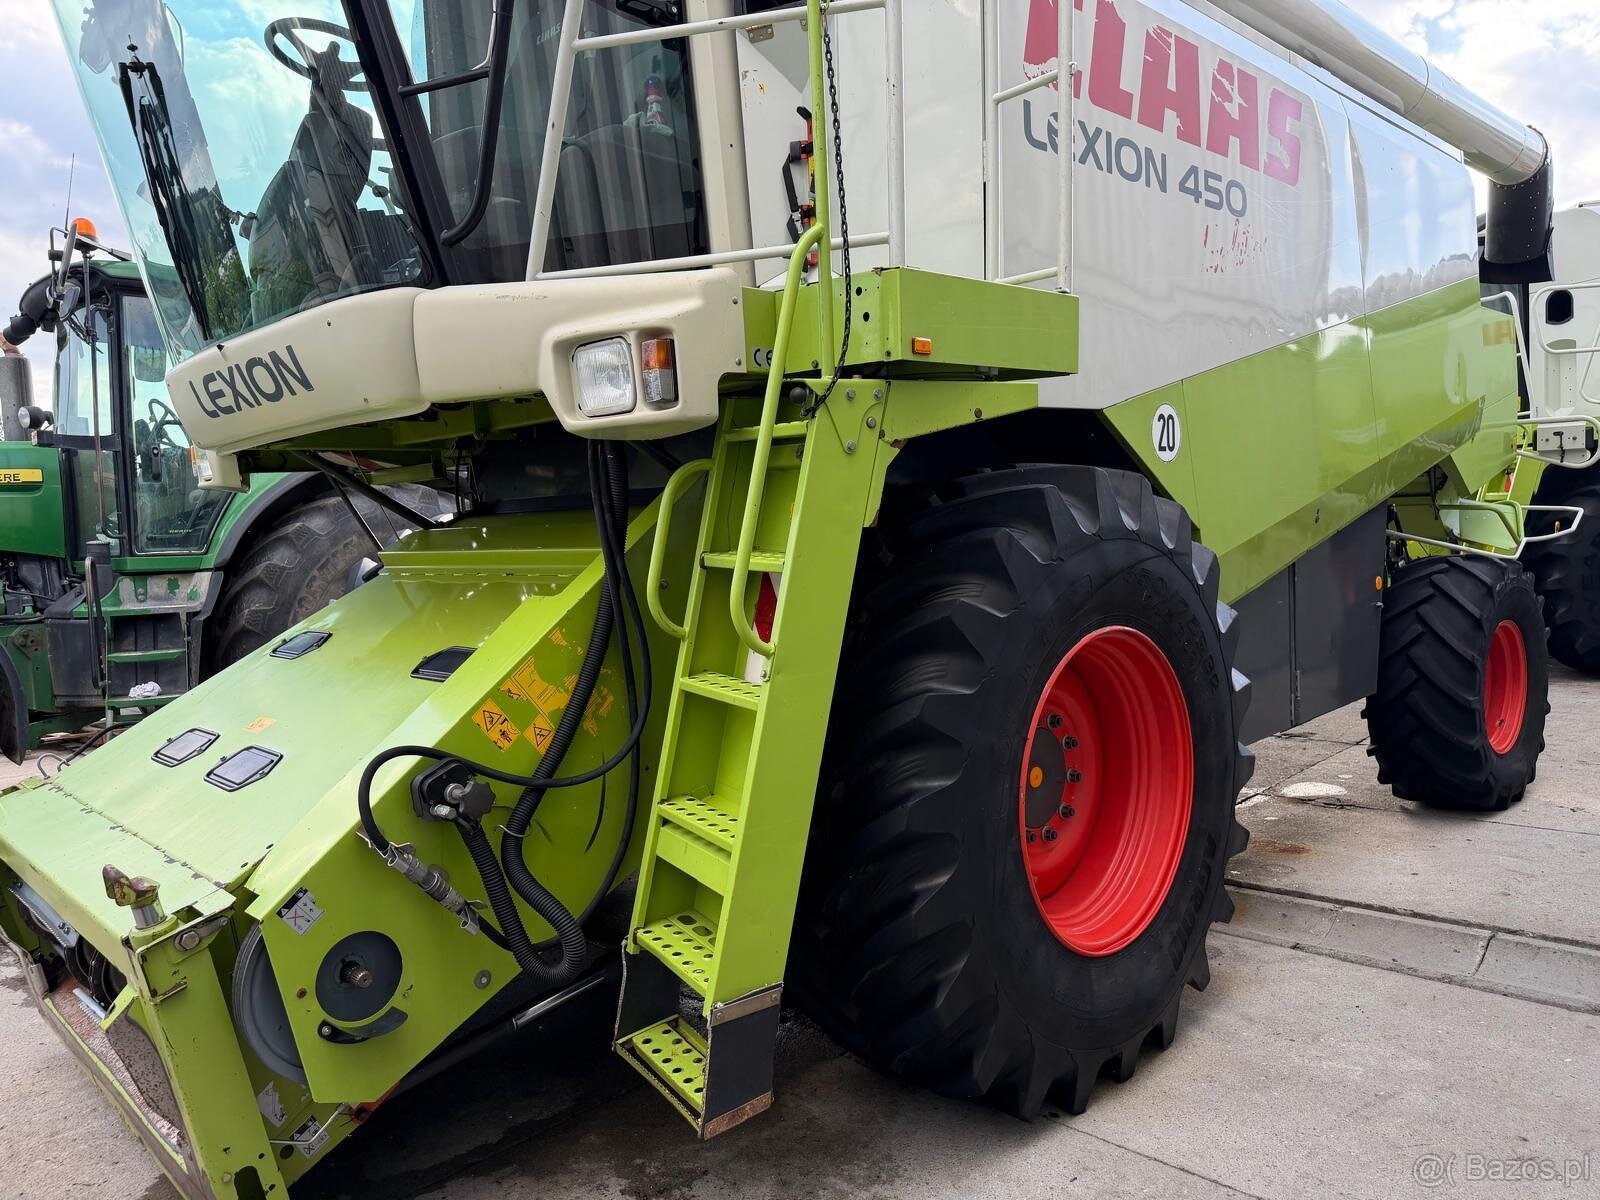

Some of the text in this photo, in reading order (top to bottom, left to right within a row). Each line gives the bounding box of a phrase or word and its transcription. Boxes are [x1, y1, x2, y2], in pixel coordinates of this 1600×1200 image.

[1178, 164, 1248, 218] 450
[188, 344, 315, 419] LEXION
[1157, 413, 1176, 452] 20
